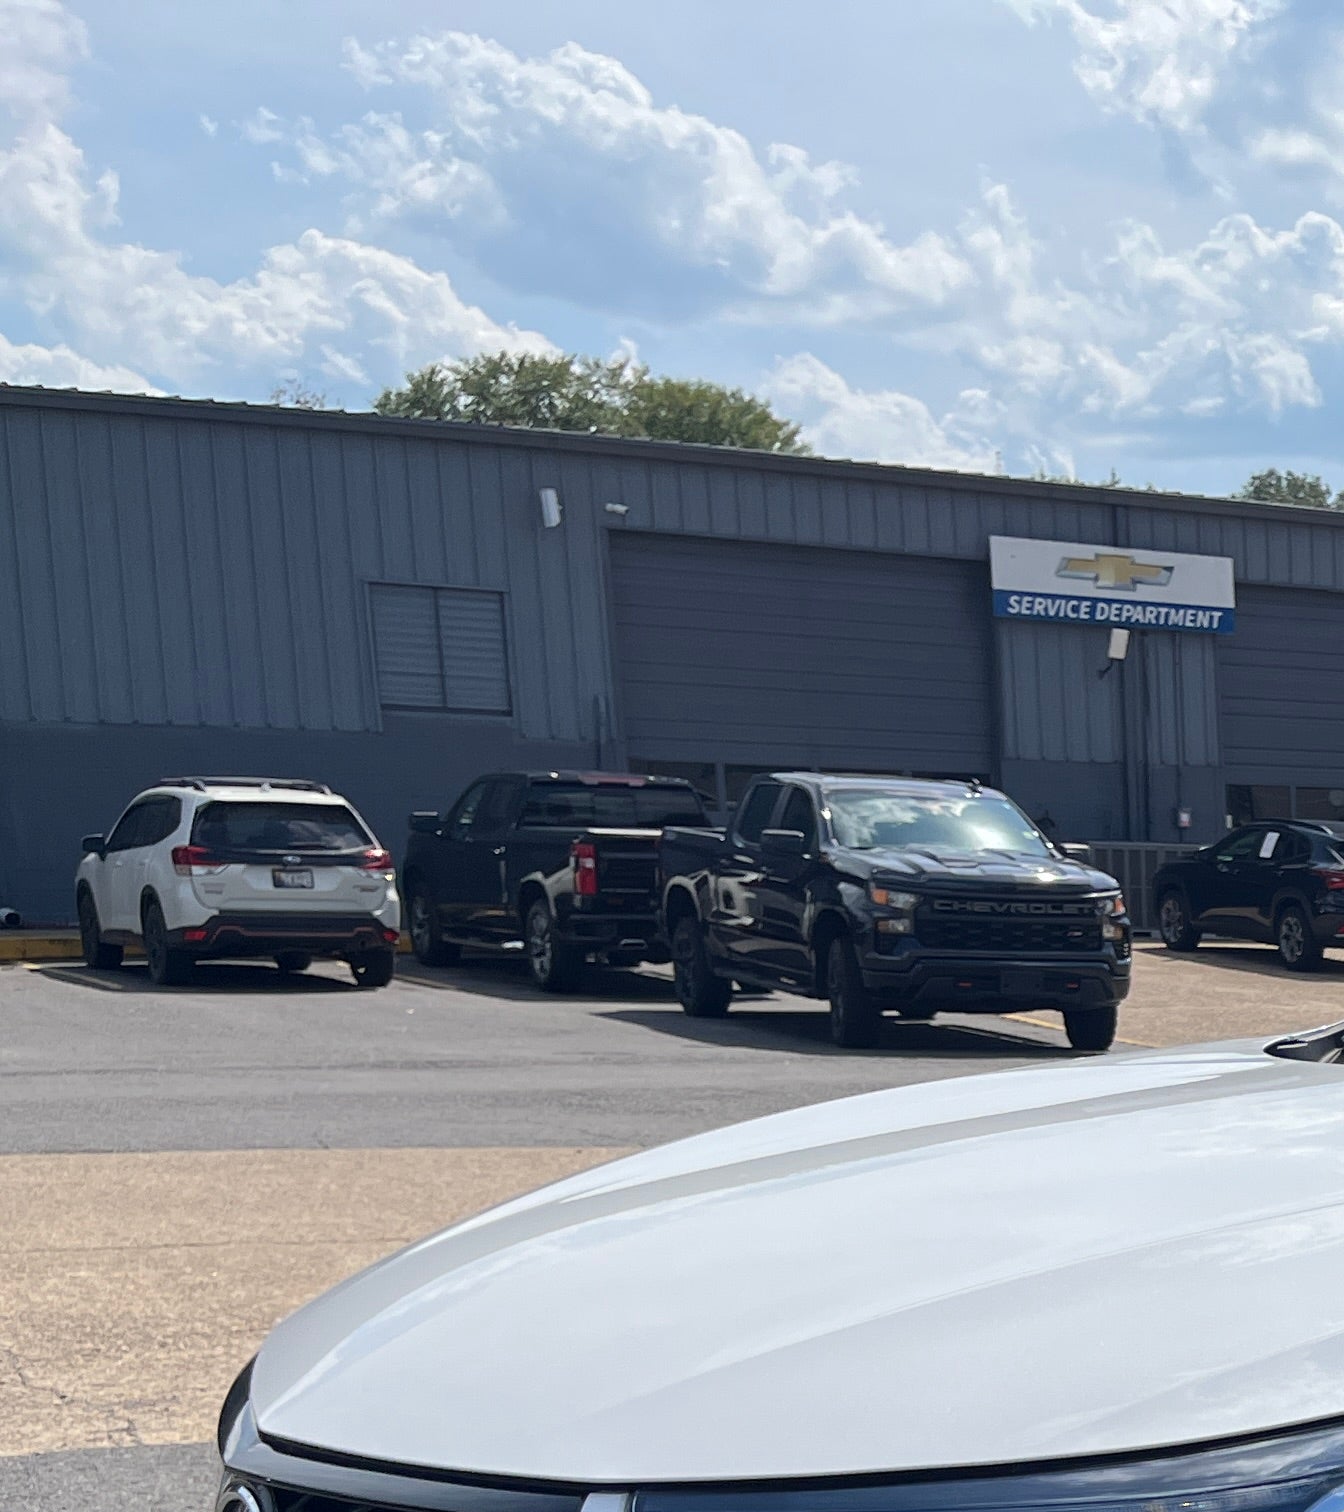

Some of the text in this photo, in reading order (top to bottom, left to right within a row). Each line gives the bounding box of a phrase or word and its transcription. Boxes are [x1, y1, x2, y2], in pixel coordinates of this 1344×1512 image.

[1007, 595, 1223, 629] SERVICE DEPARTMENT
[933, 901, 1094, 914] CHEVROLET
